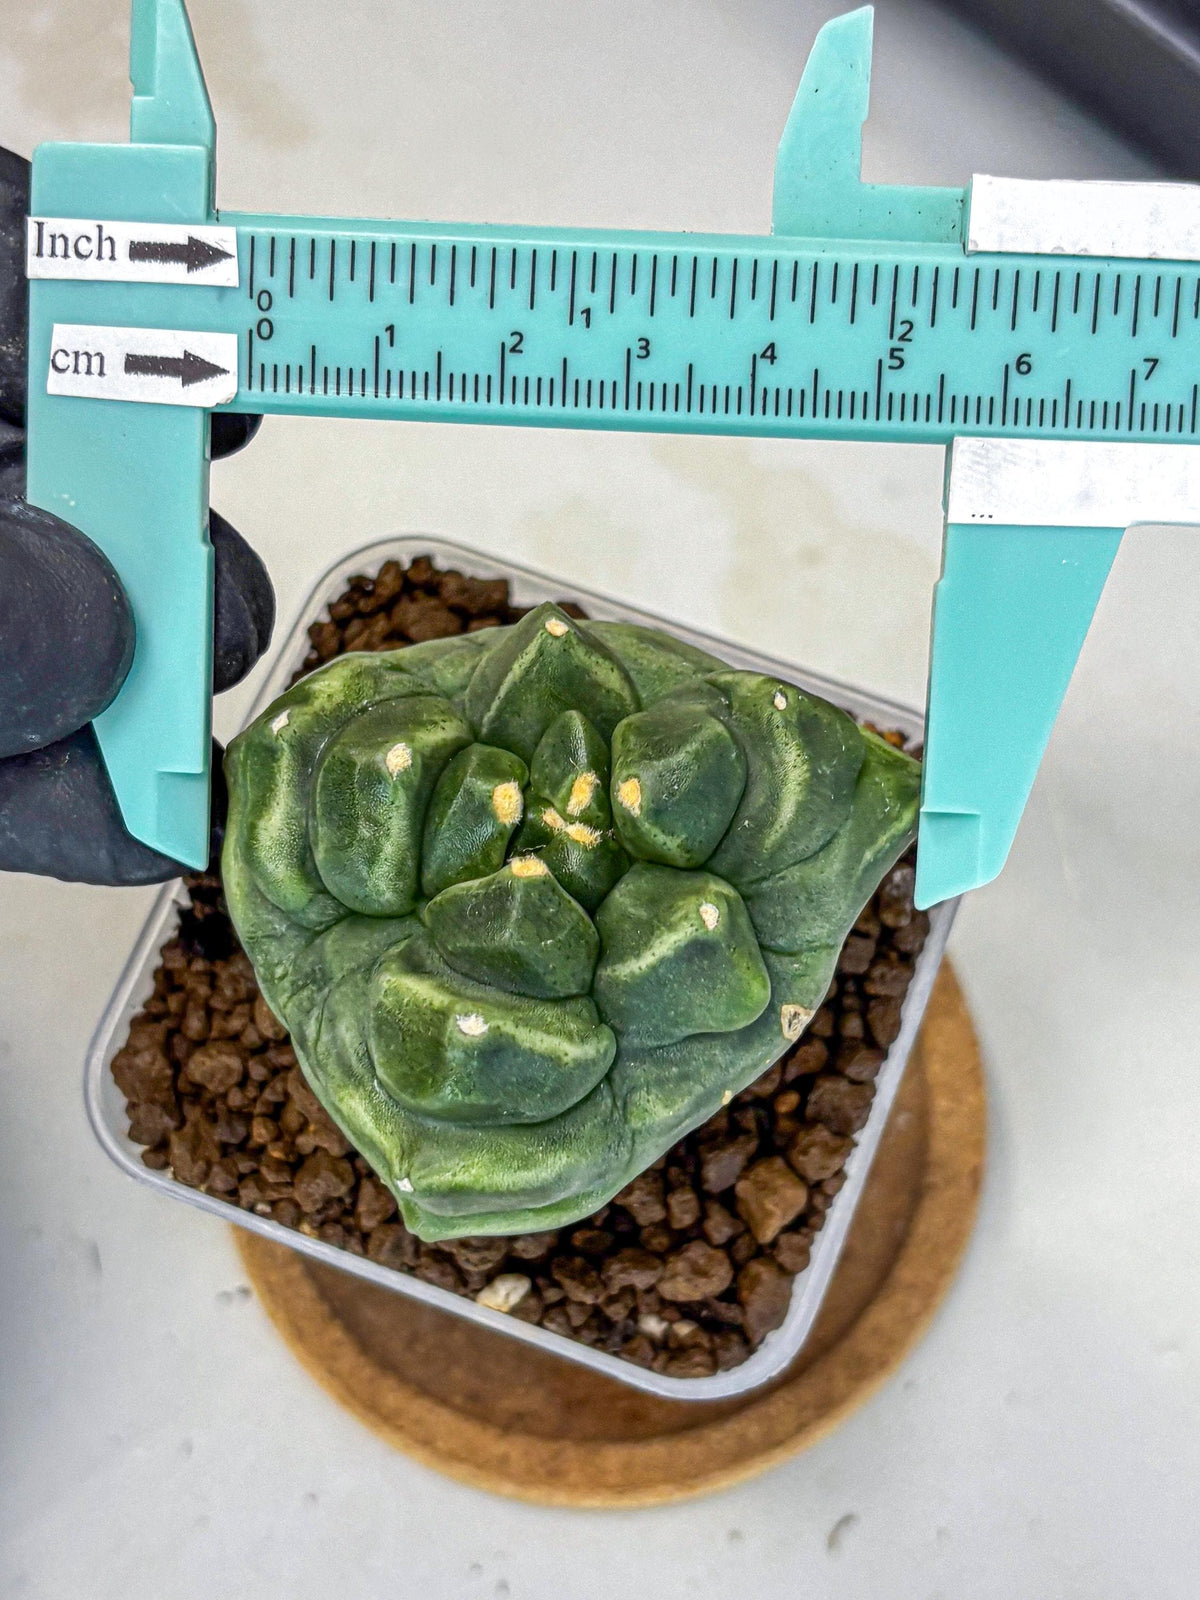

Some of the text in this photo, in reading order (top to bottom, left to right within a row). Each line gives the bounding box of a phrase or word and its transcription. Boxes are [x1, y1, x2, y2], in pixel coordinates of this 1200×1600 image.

[33, 221, 118, 262] Inch
[256, 289, 914, 342] 0 1 2
[50, 347, 107, 377] cm
[256, 318, 1160, 380] 0 1 2 3 4 5 6 7
